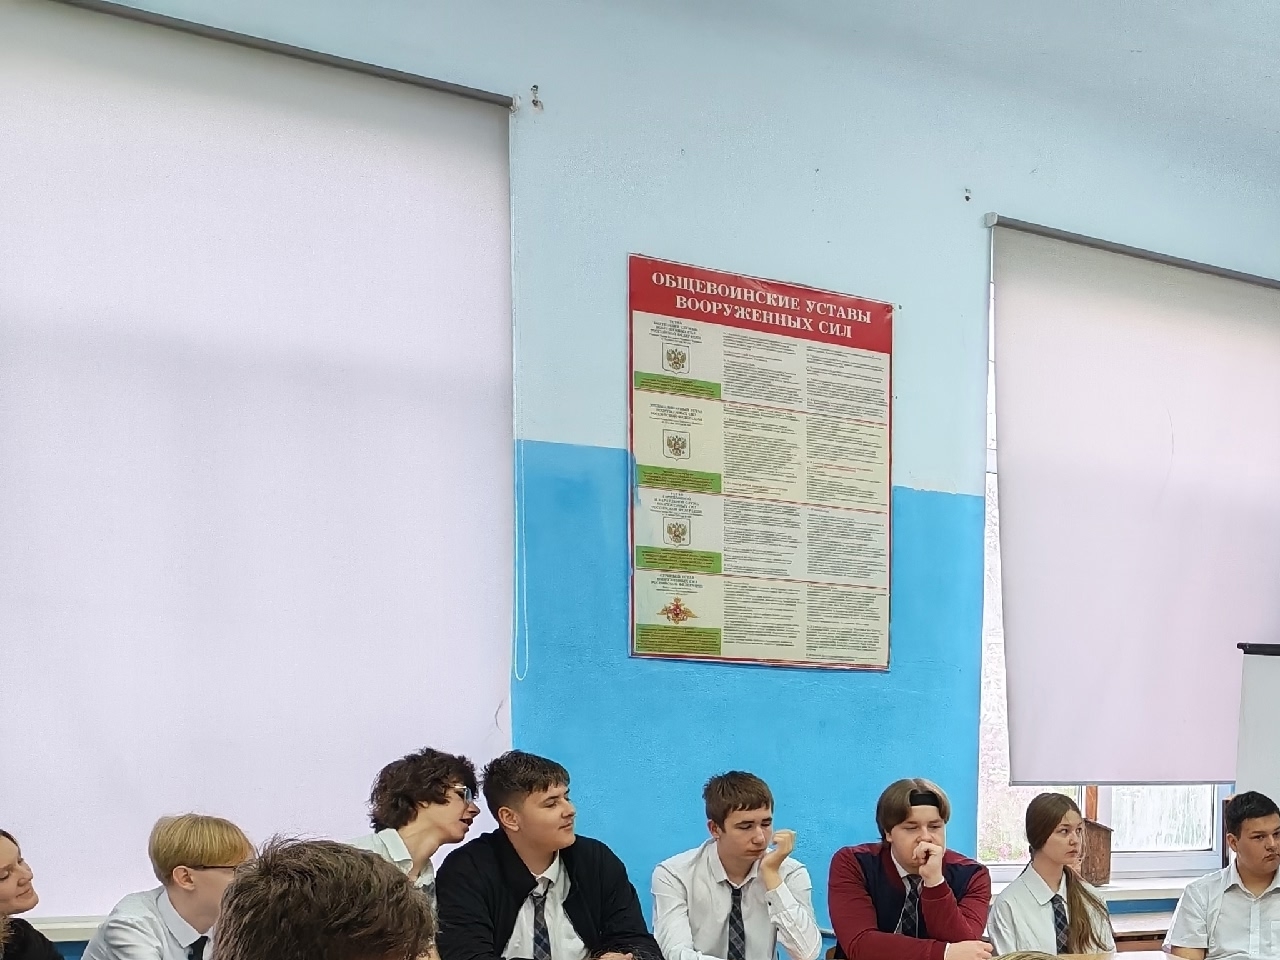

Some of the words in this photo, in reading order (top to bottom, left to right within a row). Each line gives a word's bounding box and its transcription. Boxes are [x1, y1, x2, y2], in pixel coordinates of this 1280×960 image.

[652, 272, 800, 310] ОБЩЕВОИНСКИЕ
[806, 301, 872, 324] УСТАВЫ
[676, 296, 813, 331] ВООРУЖЕННЫХ
[818, 322, 853, 338] СИЛ
